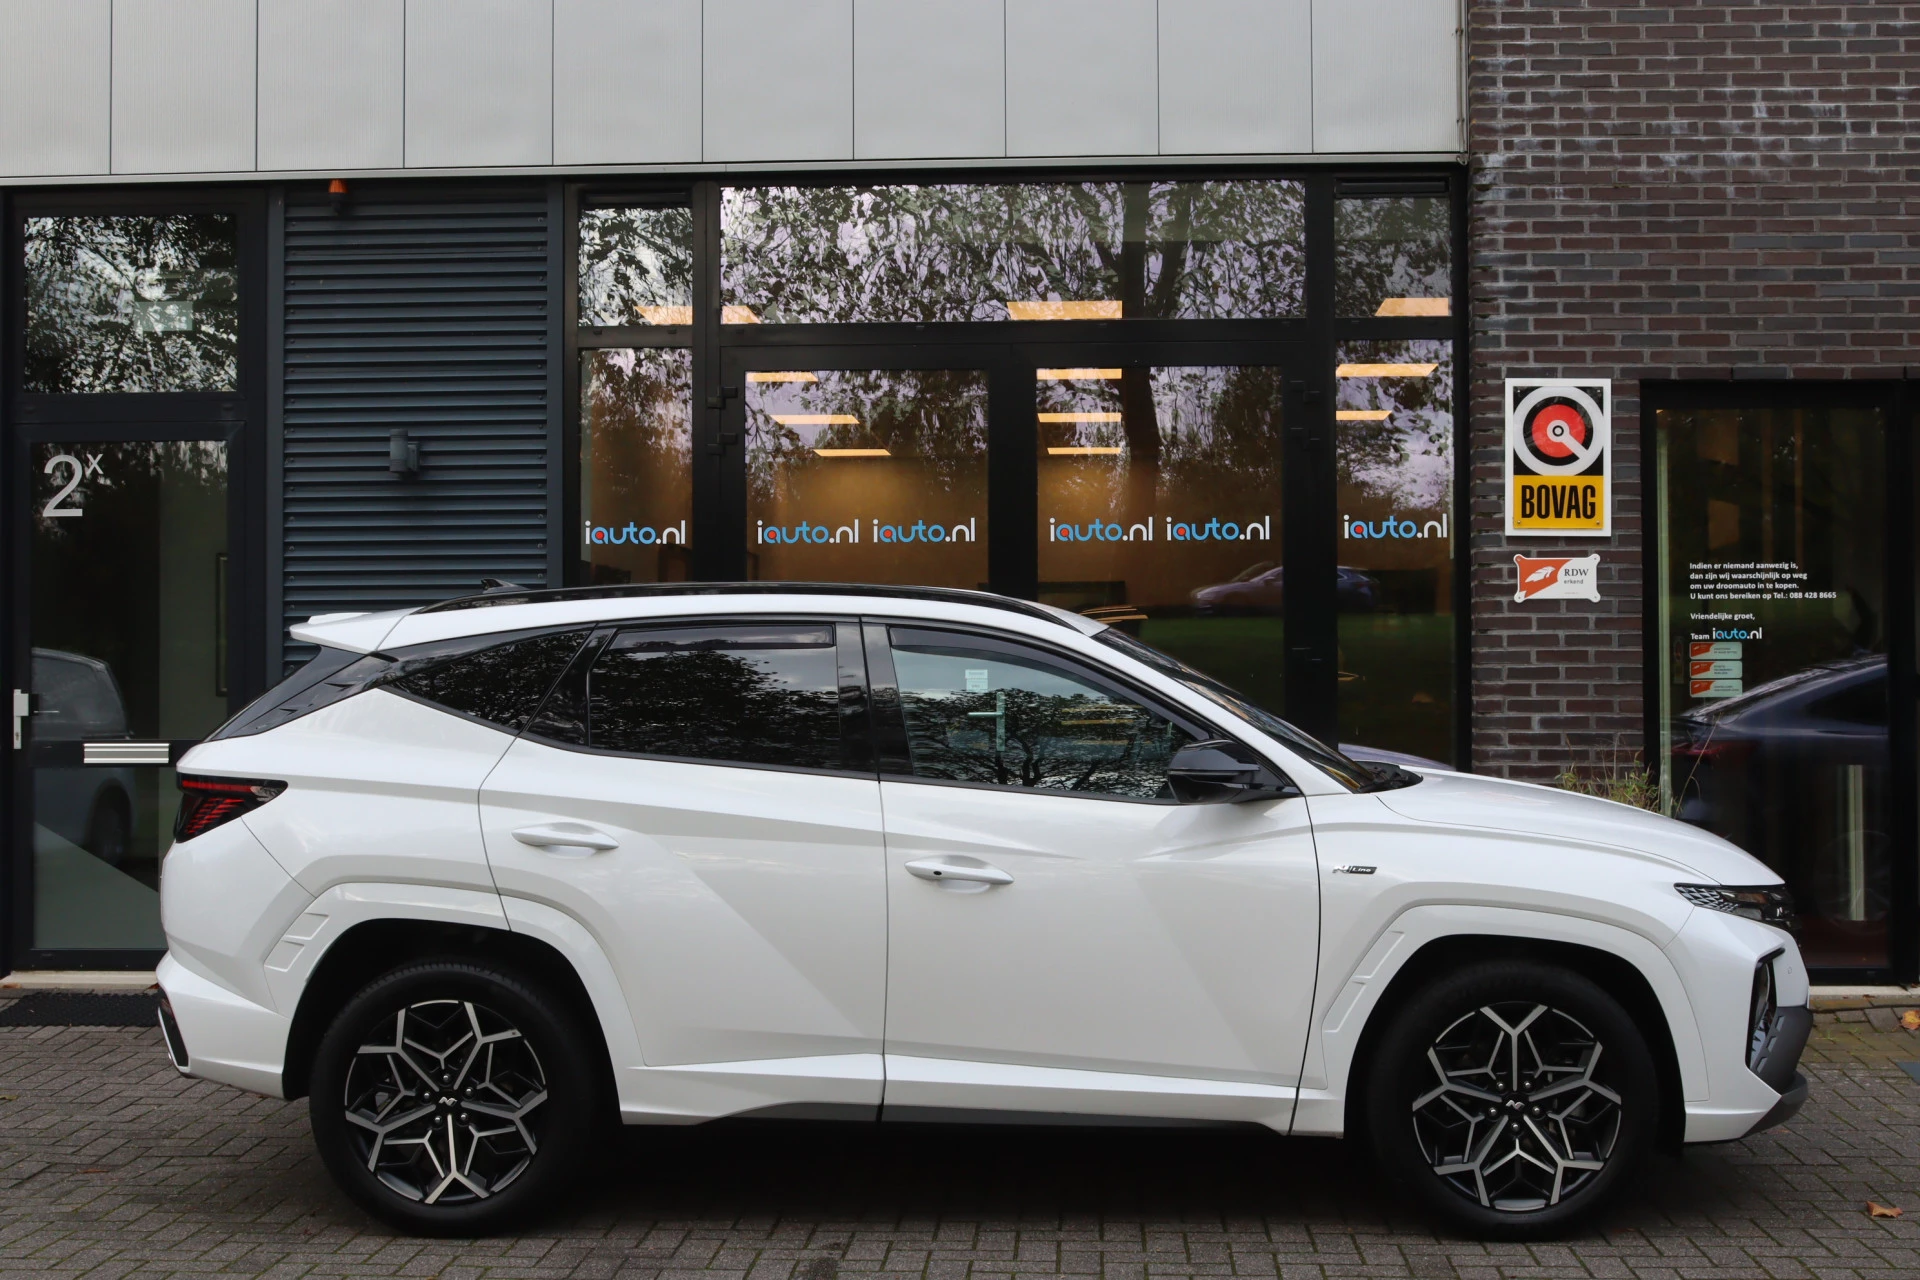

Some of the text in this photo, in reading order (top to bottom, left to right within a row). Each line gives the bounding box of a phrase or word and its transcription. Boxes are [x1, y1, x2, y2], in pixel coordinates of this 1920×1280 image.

[1521, 484, 1596, 519] BOVAG
[757, 517, 976, 544] iauto.nl iauto.nl
[1049, 515, 1270, 542] iauto.nl iauto.nl
[1343, 513, 1447, 539] iauto.nl
[585, 520, 686, 544] iauto.nl
[1756, 562, 1789, 570] aanwezig
[1790, 562, 1799, 570] is,
[1564, 568, 1589, 577] RDW
[1690, 572, 1703, 580] dan
[1705, 572, 1718, 581] zijn
[1719, 572, 1730, 581] wij
[1731, 571, 1780, 580] waarschijnlijk
[1781, 572, 1791, 580] op
[1775, 581, 1800, 590] kopen.
[1690, 592, 1696, 600] U
[1697, 592, 1714, 600] kunt
[1819, 591, 1837, 599] 8665
[1690, 613, 1756, 621] Vriendelijke groet,
[1712, 627, 1763, 640] iauto.nl
